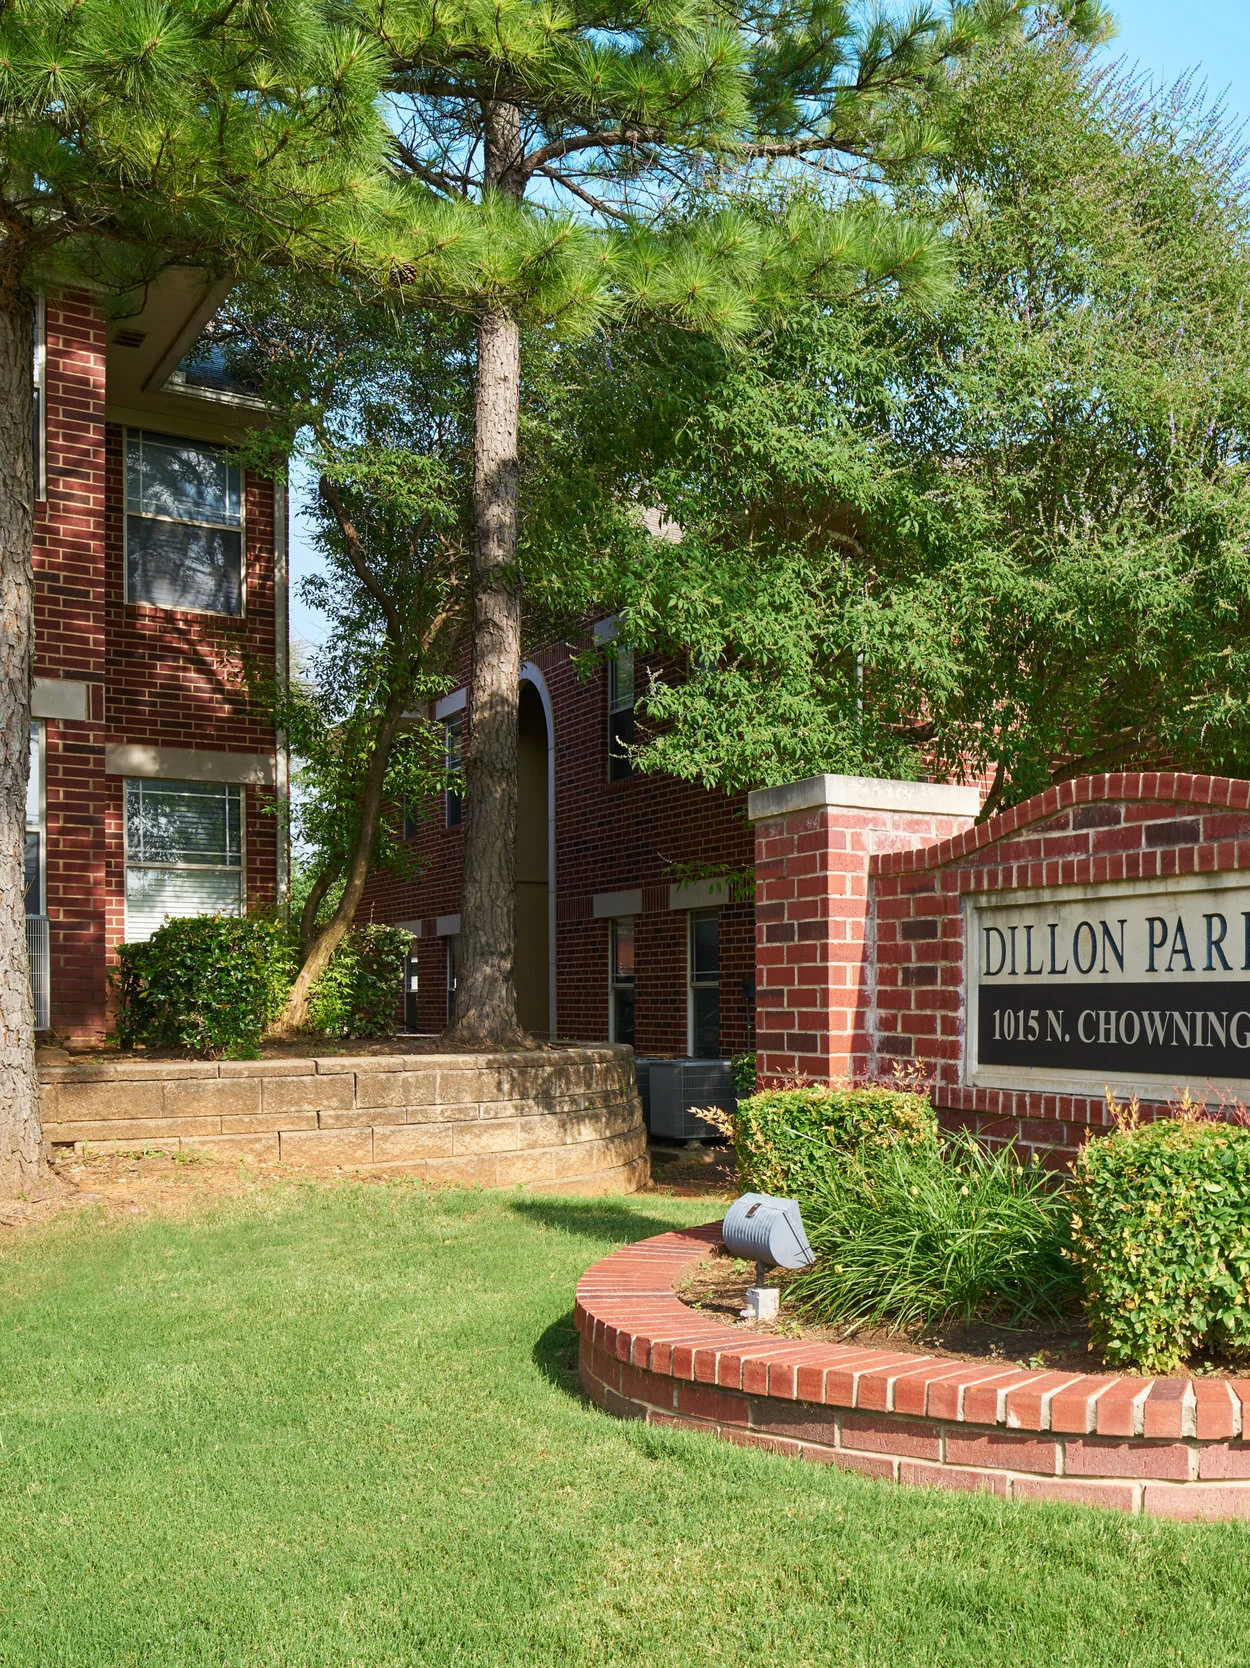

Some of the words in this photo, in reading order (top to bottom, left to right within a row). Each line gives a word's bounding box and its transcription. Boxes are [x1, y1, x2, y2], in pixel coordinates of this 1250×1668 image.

[983, 919, 1128, 976] DILLON
[992, 1009, 1040, 1042] 1015
[1046, 1009, 1070, 1043] N.
